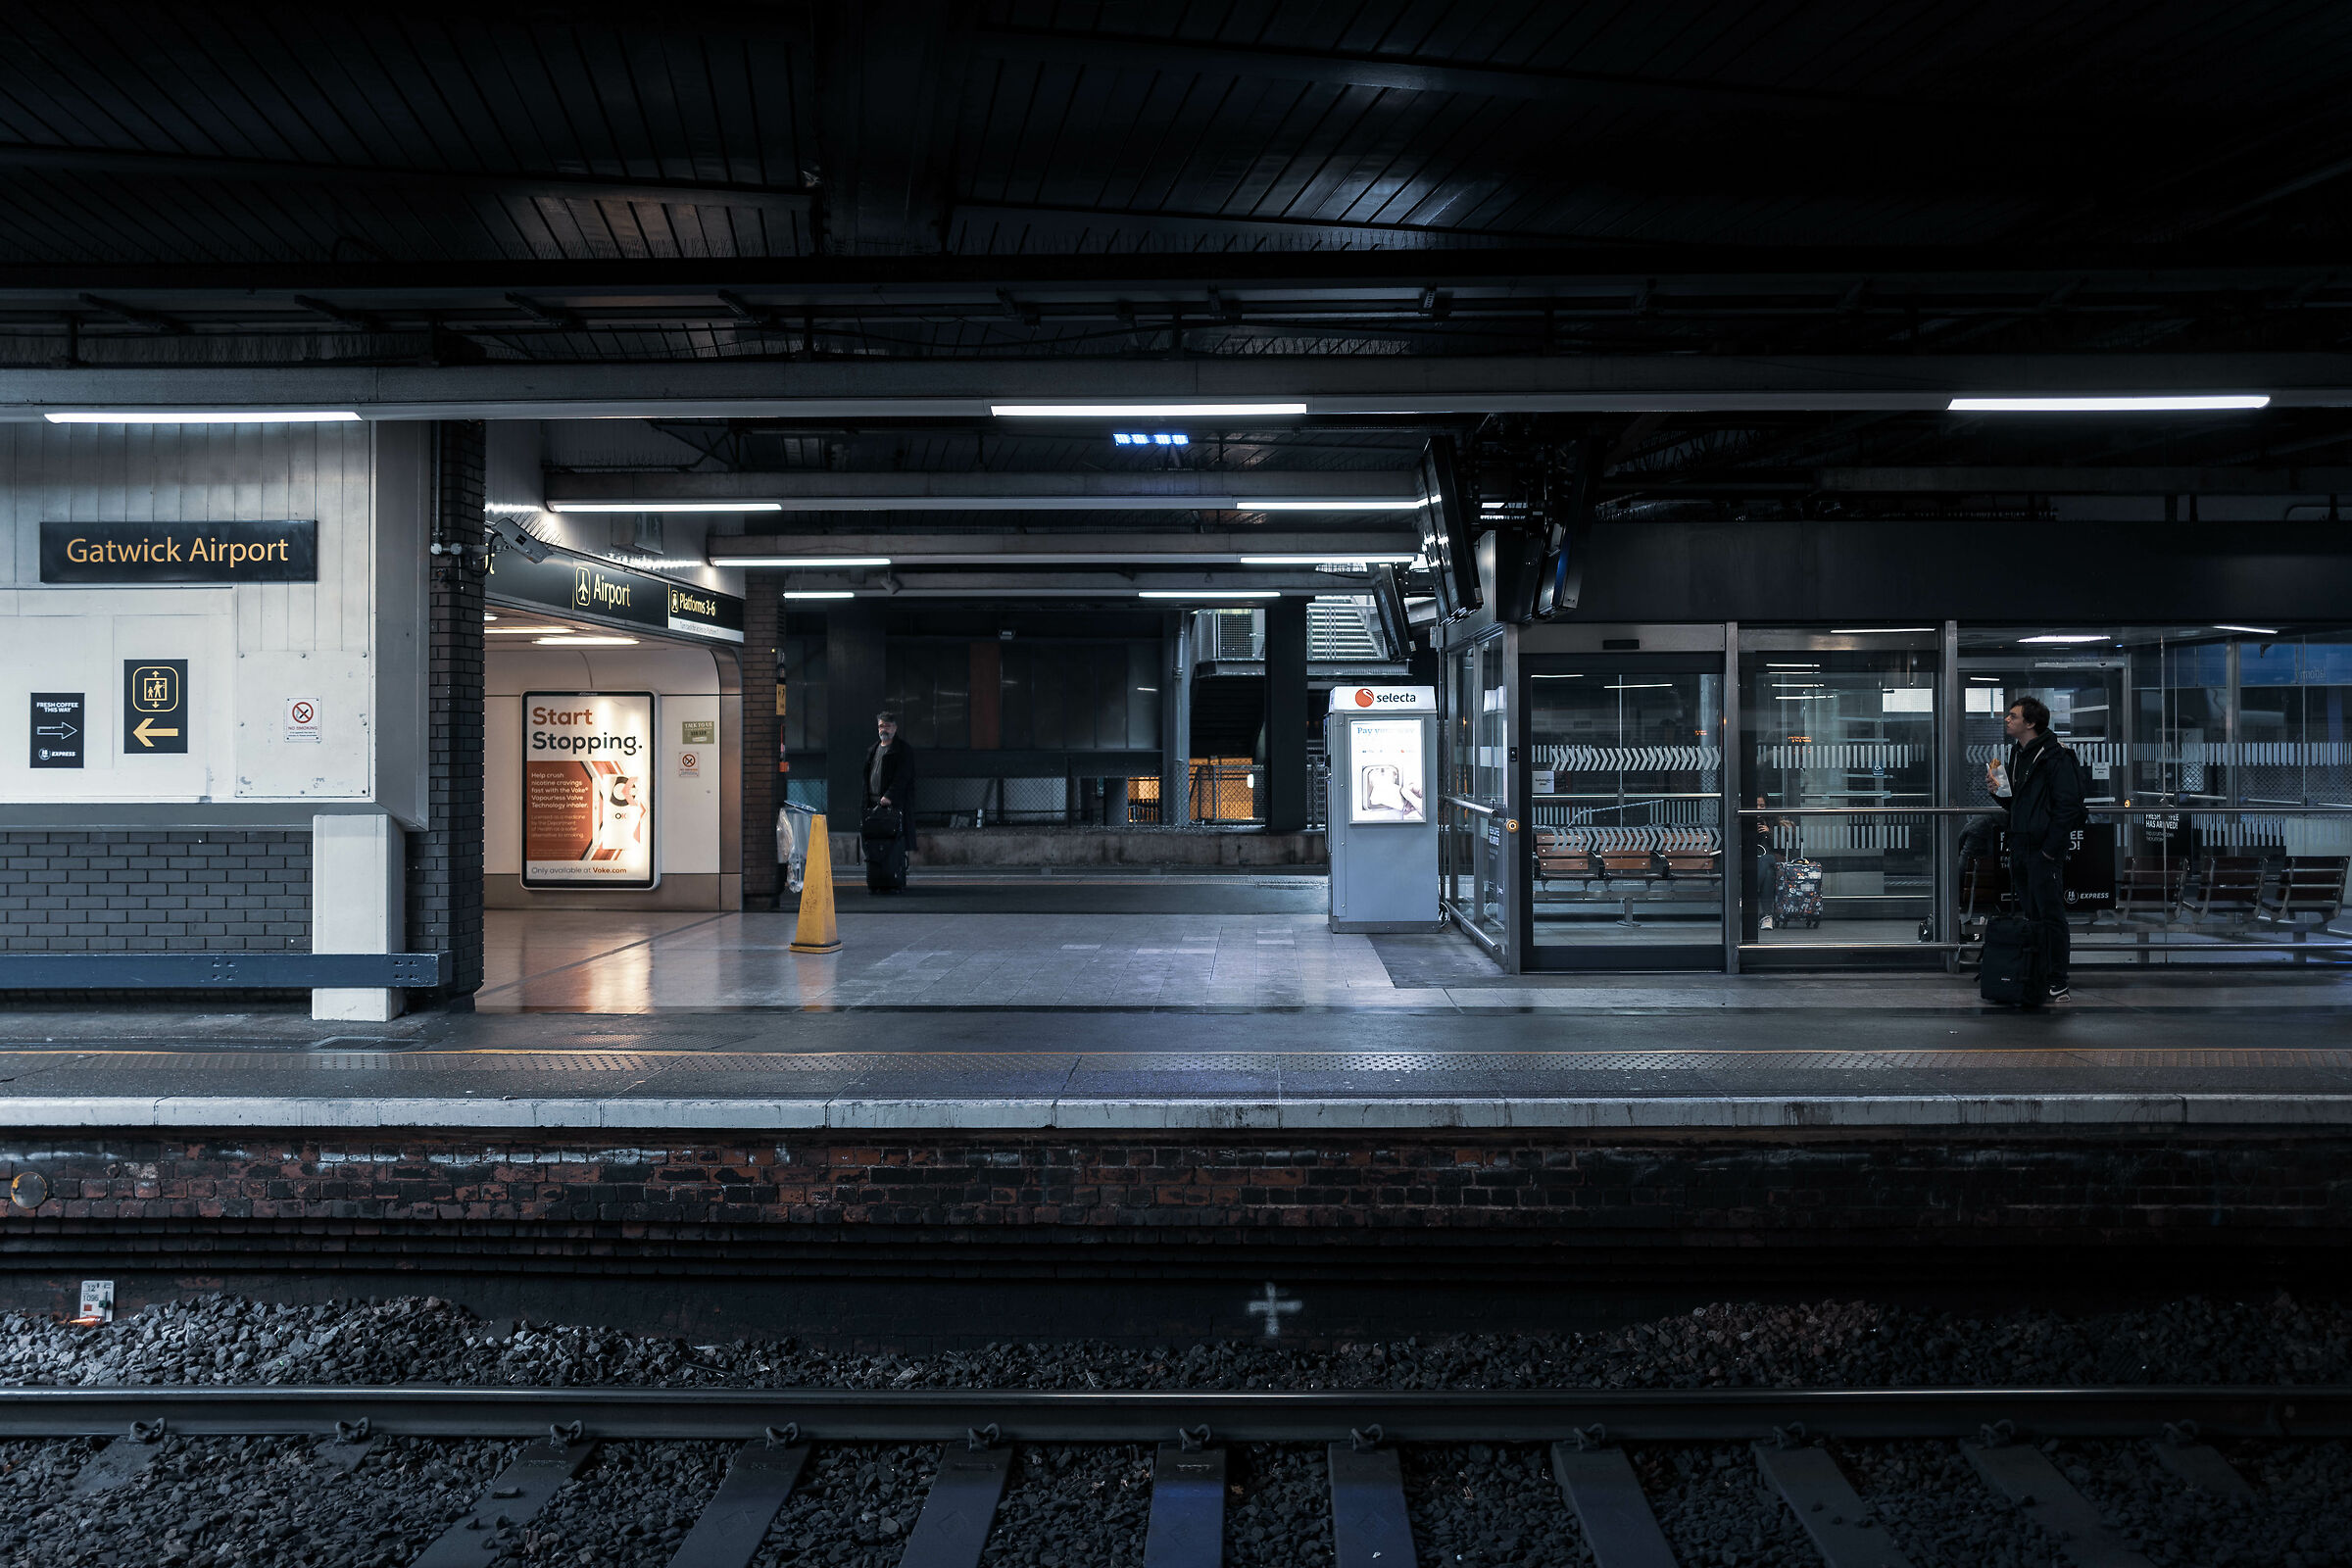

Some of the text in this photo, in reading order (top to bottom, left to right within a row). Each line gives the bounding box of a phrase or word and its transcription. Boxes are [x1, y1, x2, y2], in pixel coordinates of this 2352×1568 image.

[67, 537, 289, 568] Gatwick Airport
[593, 573, 631, 611] Airport
[679, 592, 715, 616] Platforms 3-6
[1376, 693, 1416, 703] selecta
[532, 707, 593, 725] Start
[532, 731, 643, 756] Stopping.
